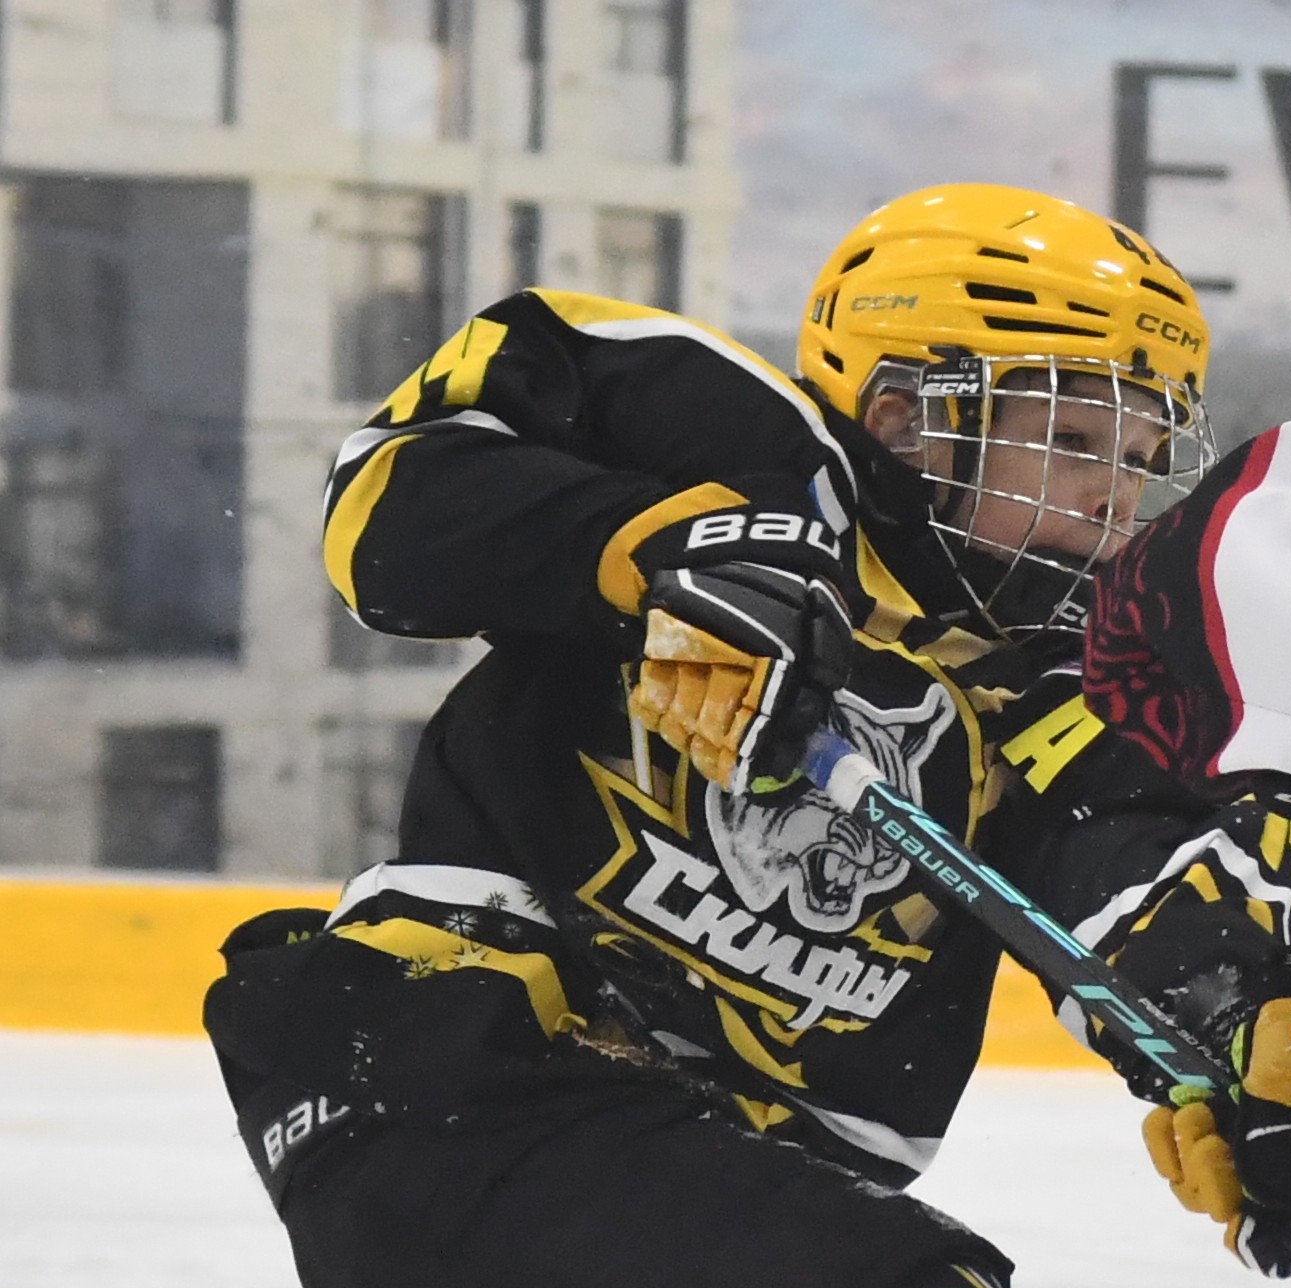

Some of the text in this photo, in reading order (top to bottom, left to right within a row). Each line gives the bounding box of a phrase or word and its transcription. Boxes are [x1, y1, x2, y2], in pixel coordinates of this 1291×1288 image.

[851, 294, 919, 312] CCM
[1135, 312, 1201, 355] CCM
[684, 512, 840, 560] BAU
[1000, 692, 1106, 795] A
